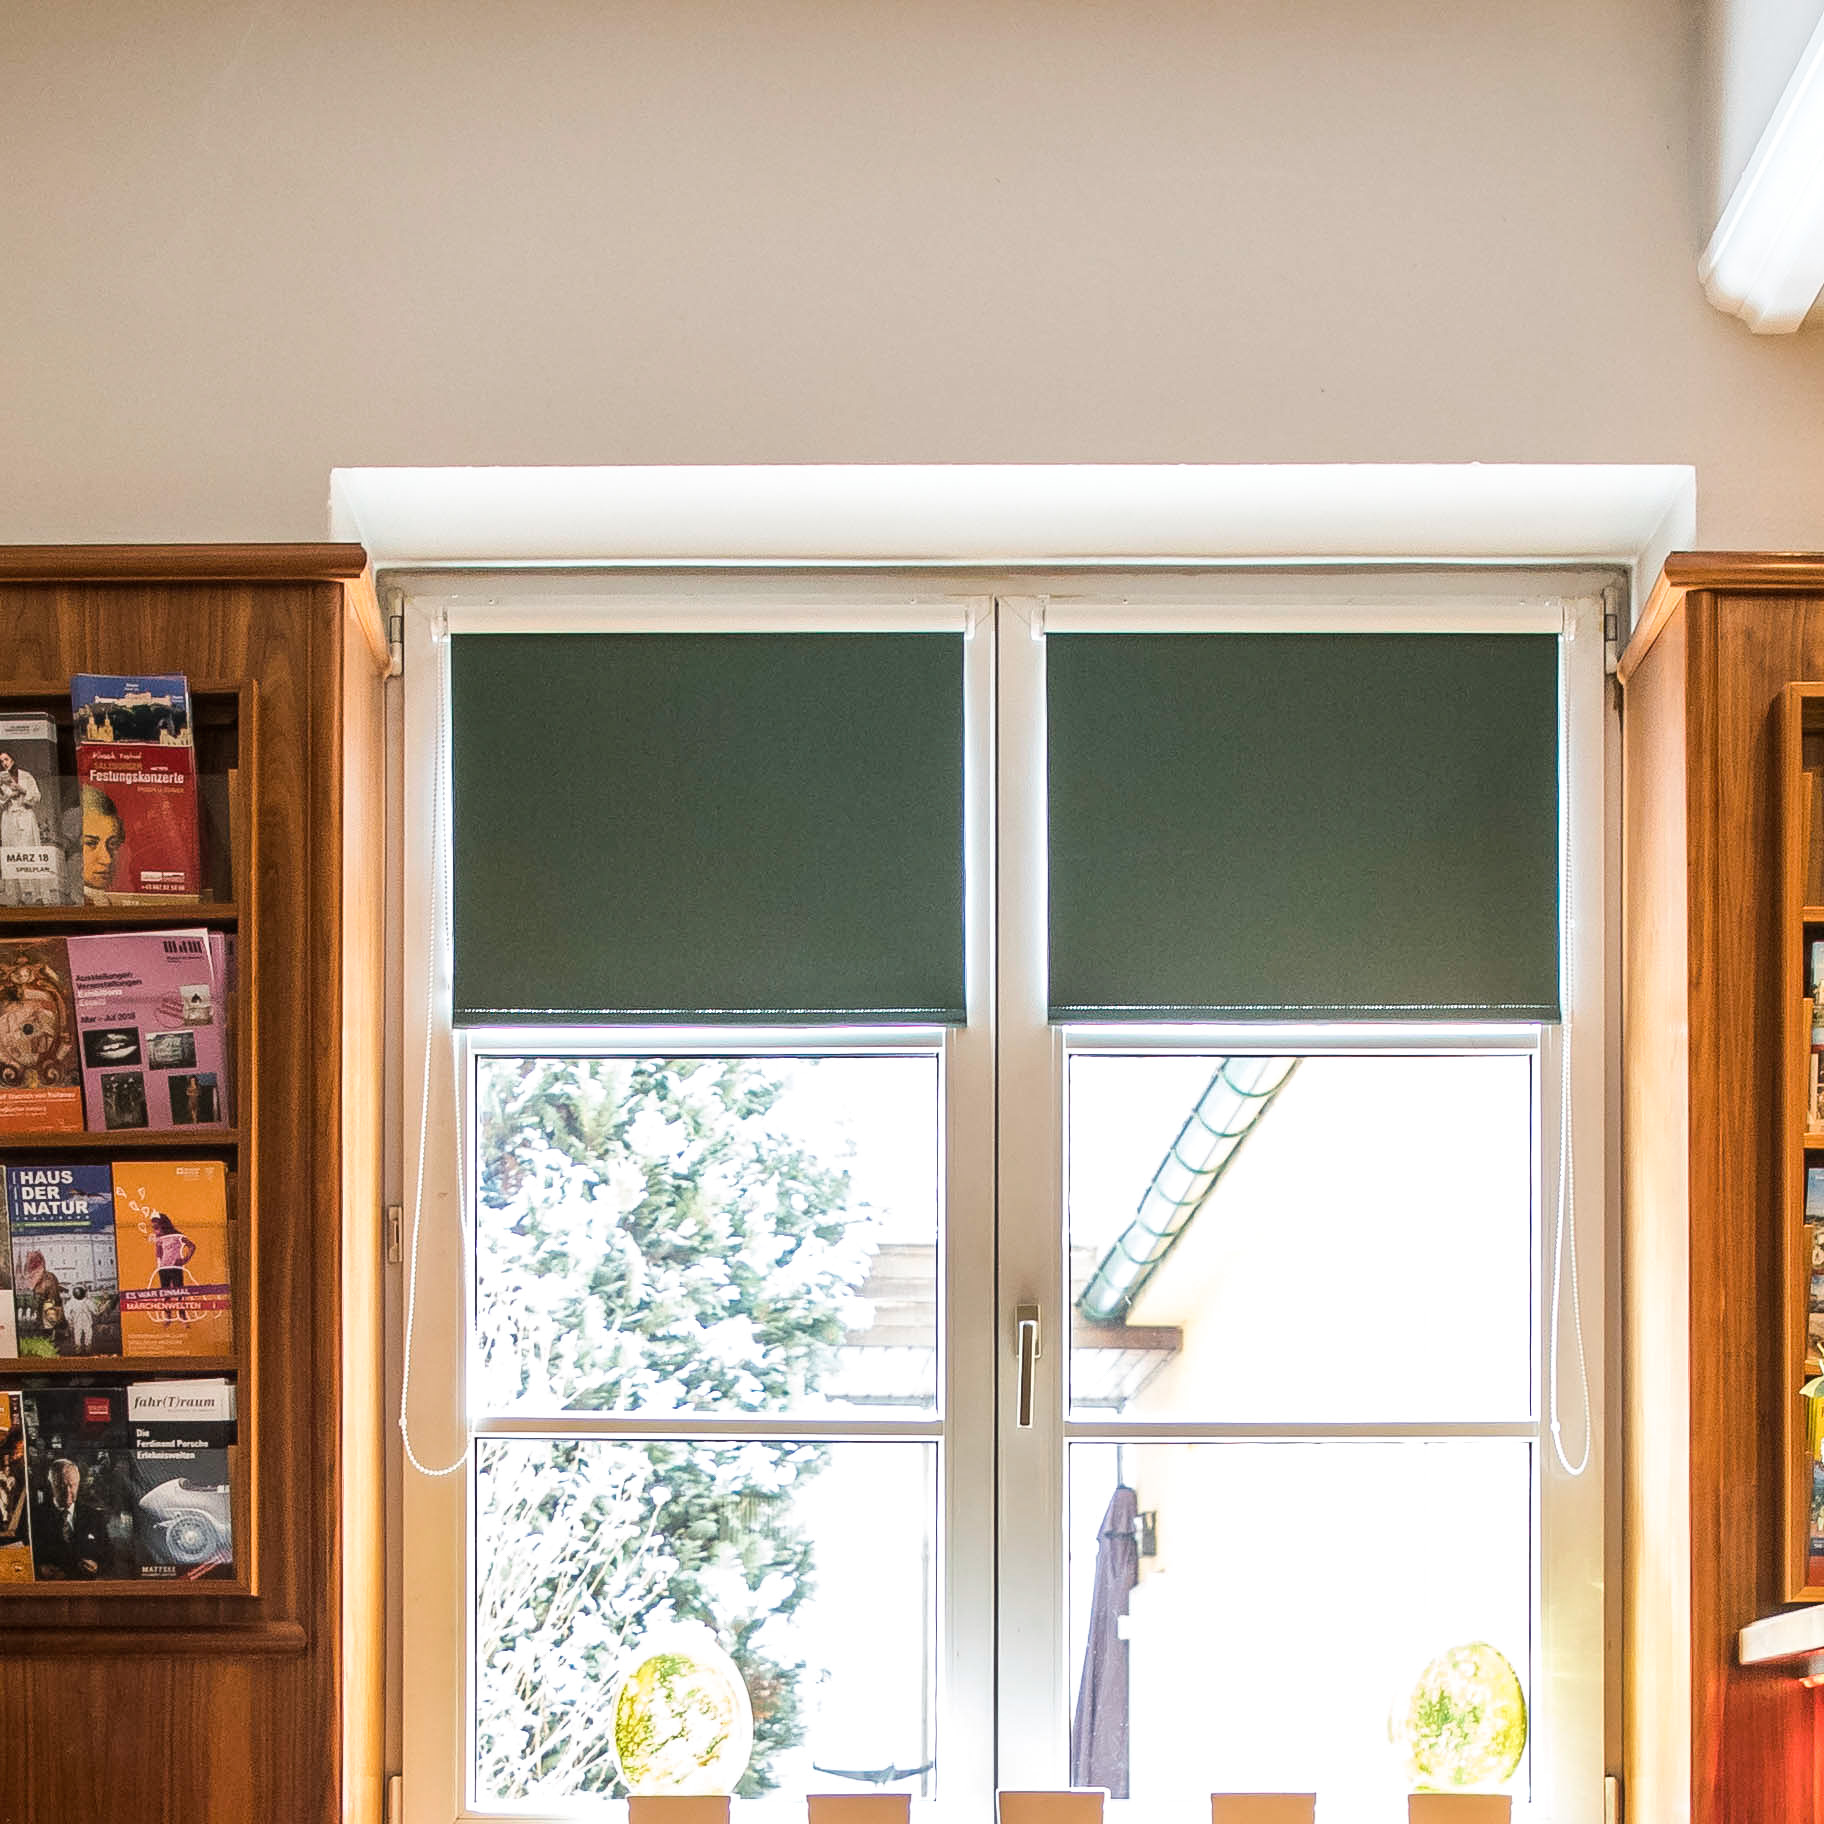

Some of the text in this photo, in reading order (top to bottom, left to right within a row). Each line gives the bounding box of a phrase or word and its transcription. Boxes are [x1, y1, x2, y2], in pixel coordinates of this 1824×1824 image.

[89, 769, 185, 785] Festungskonzerte
[38, 853, 49, 863] 18
[20, 1171, 73, 1185] HAUS
[22, 1186, 61, 1200] DER
[23, 1201, 89, 1216] NATUR
[125, 1288, 190, 1300] ES WAR EINMAL
[134, 1396, 216, 1409] fahr(T)raum
[136, 1428, 150, 1438] Die
[137, 1440, 209, 1448] Ferdinand Porsche
